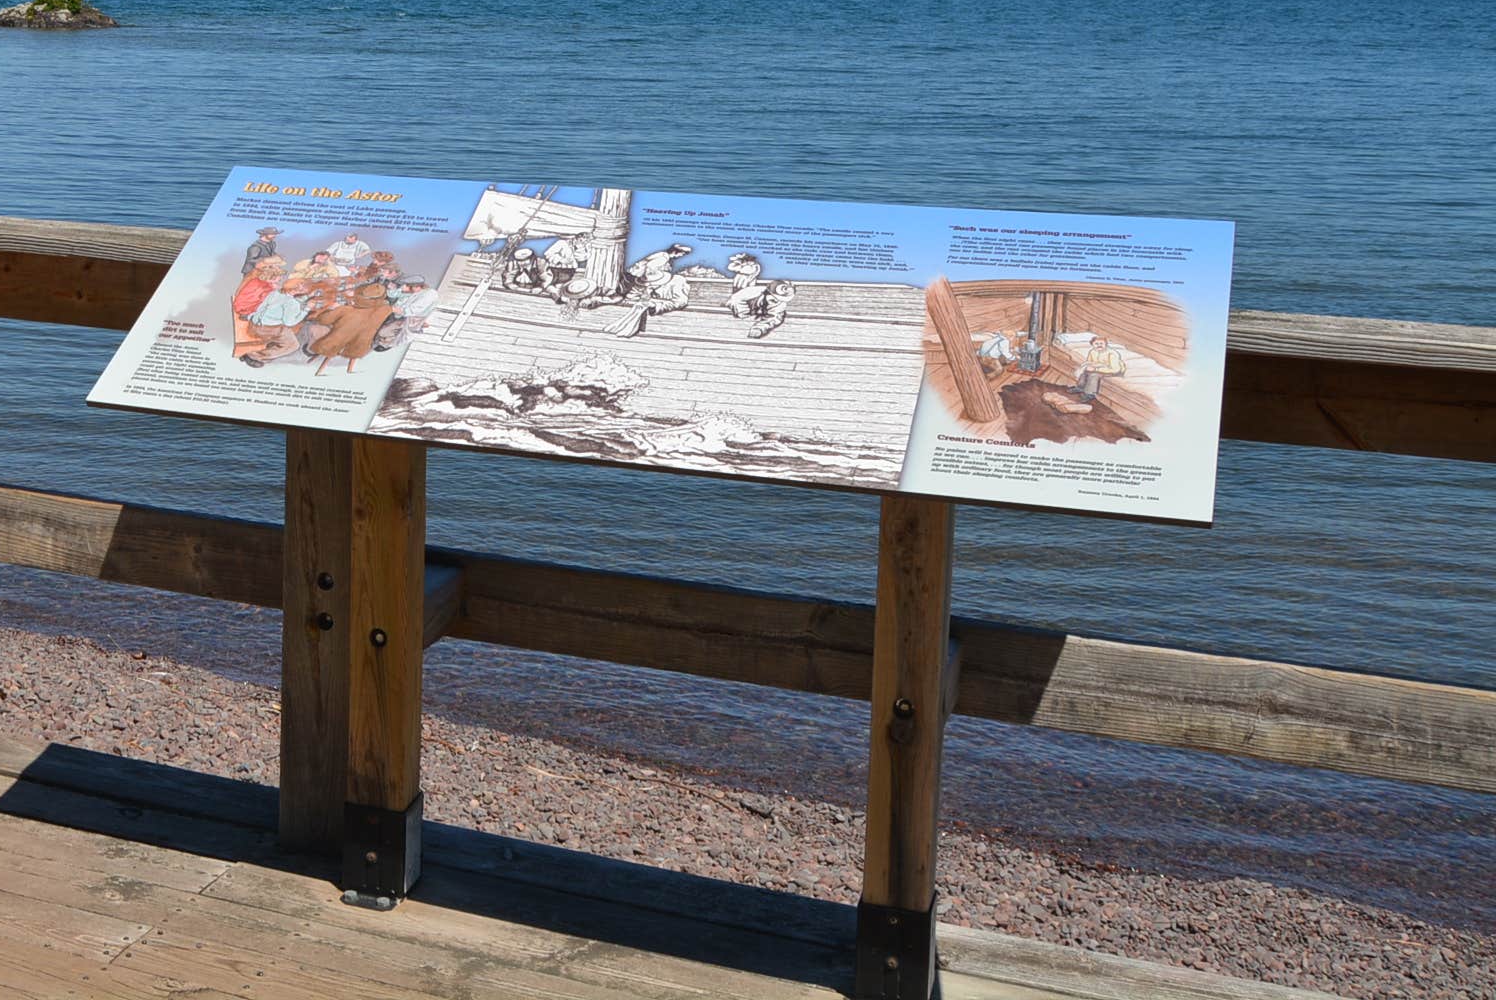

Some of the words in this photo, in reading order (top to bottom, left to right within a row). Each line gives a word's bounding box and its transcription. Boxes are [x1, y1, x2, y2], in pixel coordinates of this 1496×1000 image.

[244, 182, 279, 194] Life
[282, 186, 306, 196] on
[311, 187, 342, 198] the
[346, 189, 403, 203] Astor
[937, 434, 983, 444] Creature
[986, 438, 1036, 448] Comforts
